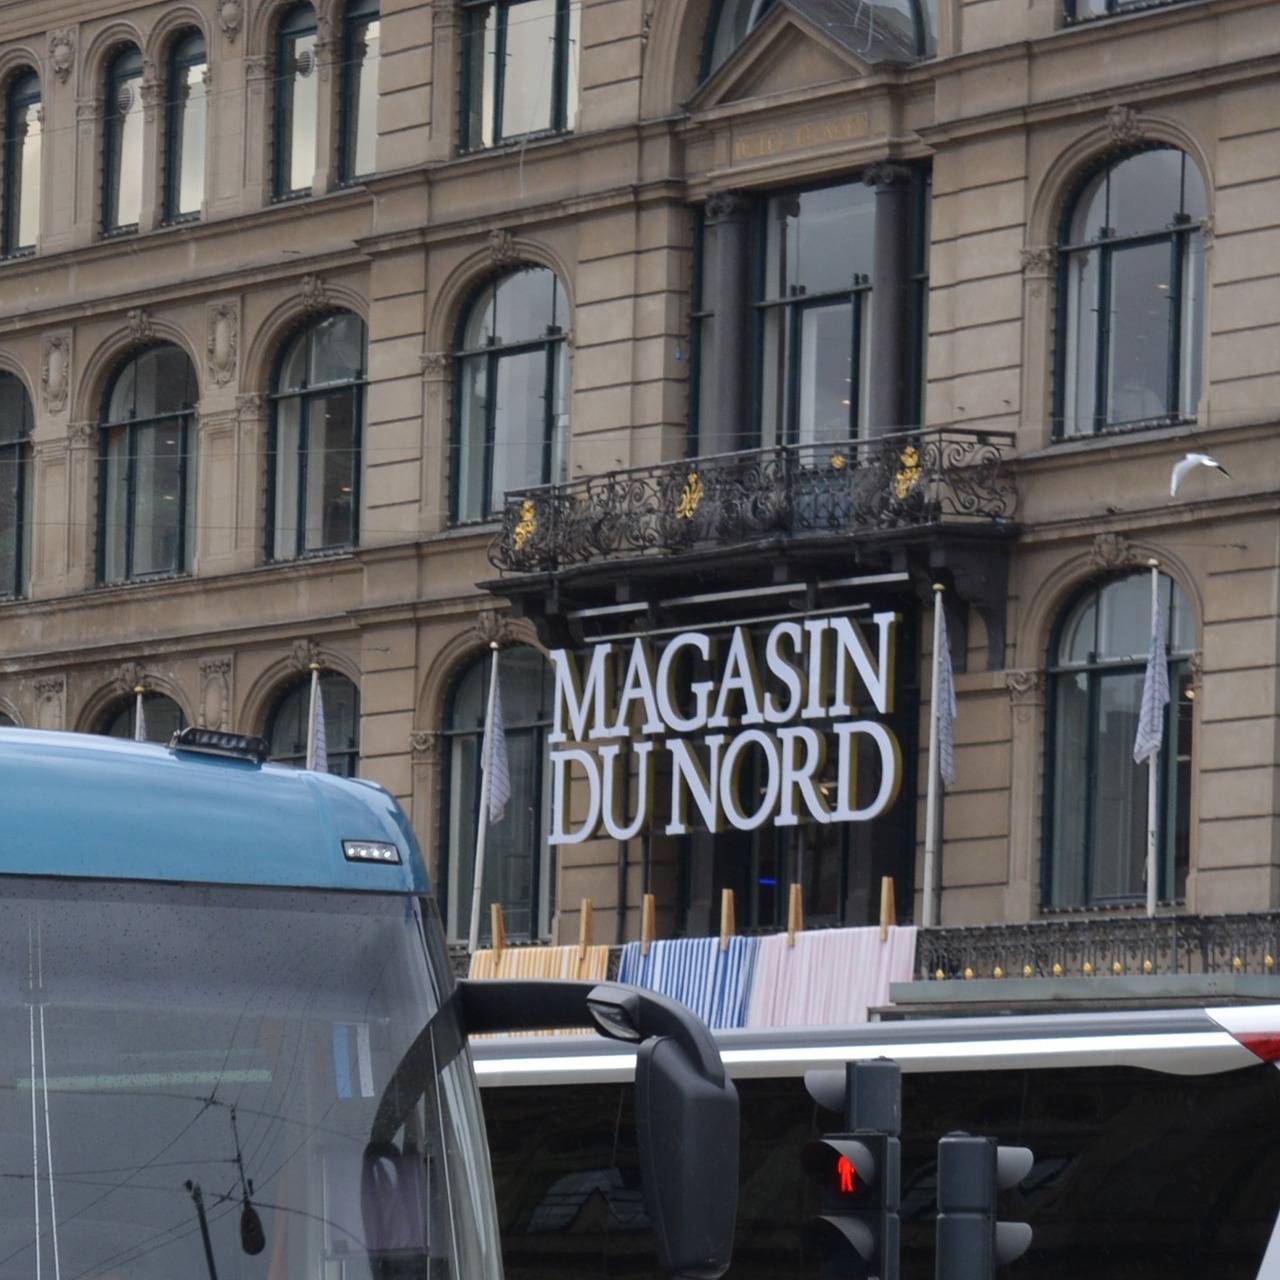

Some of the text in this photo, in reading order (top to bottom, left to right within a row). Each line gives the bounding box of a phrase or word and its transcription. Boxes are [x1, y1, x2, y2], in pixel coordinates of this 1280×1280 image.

[547, 611, 897, 744] MAGASIN
[547, 719, 900, 846] DU NORD
